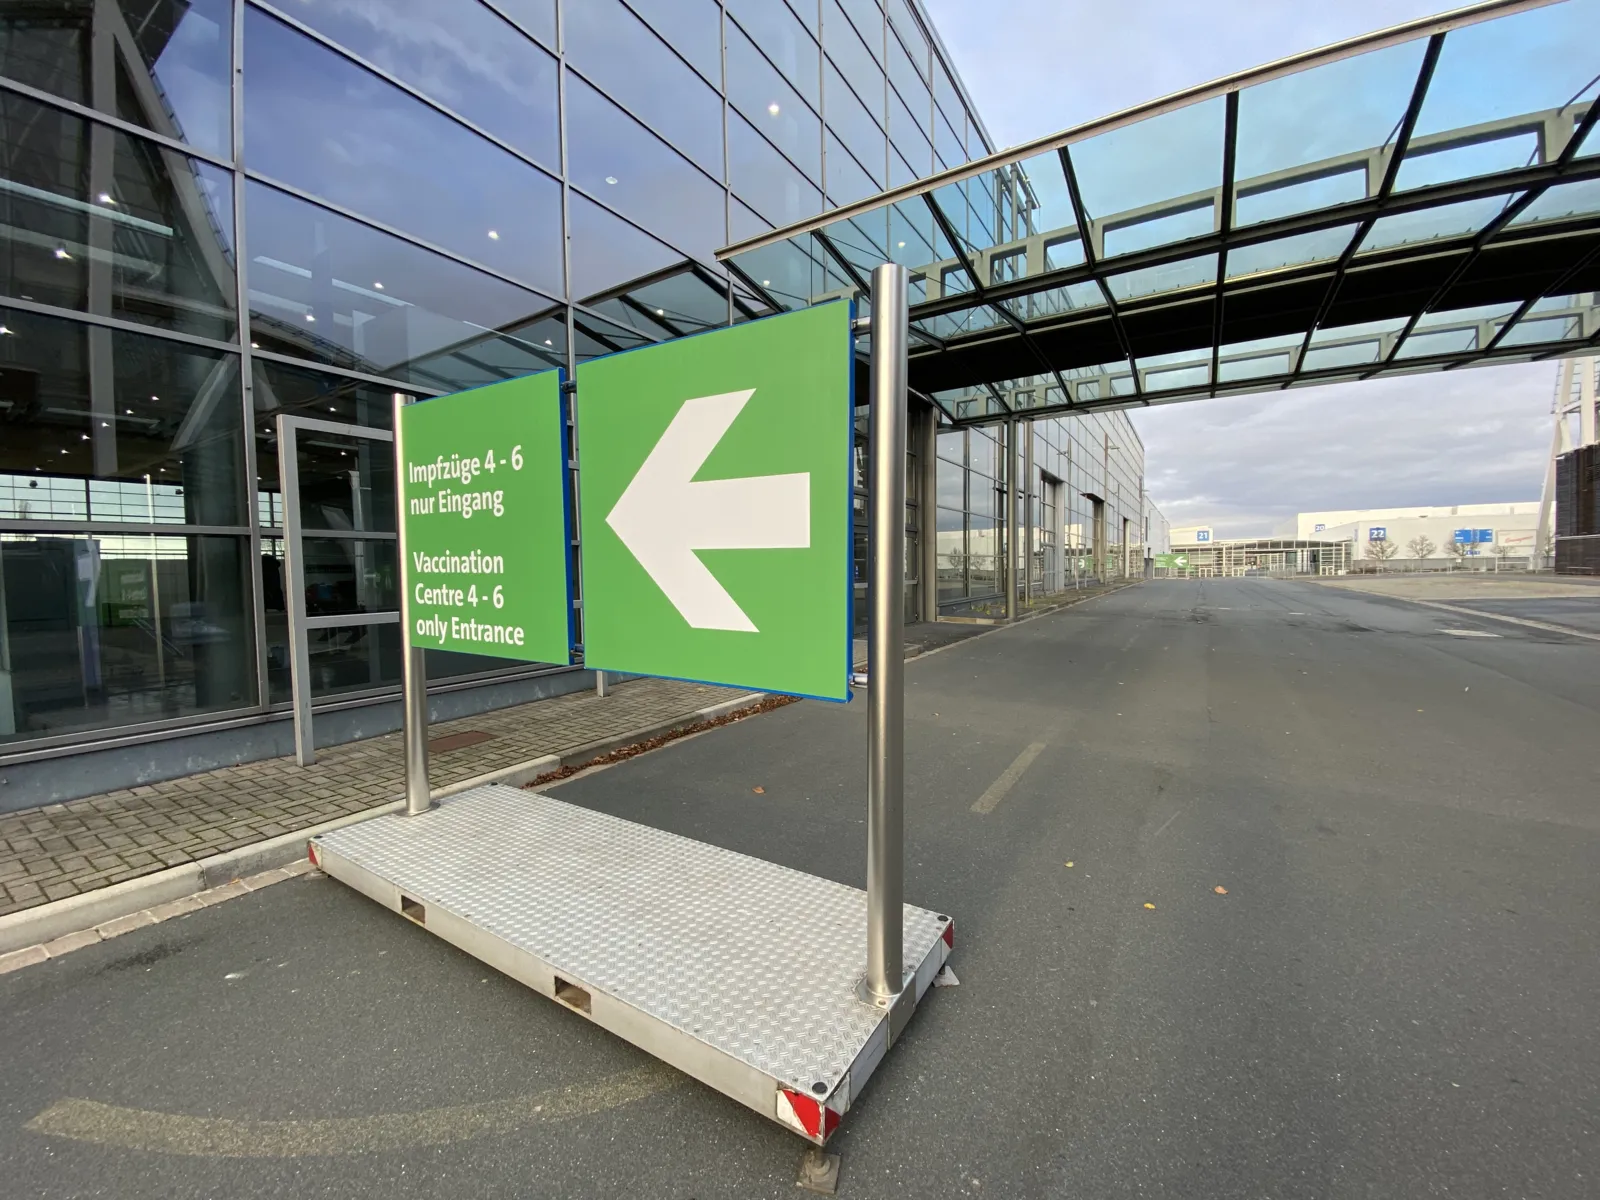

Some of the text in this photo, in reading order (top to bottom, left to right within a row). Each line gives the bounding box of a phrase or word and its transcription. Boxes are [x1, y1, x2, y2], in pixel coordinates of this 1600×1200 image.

[408, 454, 481, 489] Impfzüge
[484, 449, 496, 474] 4
[511, 444, 524, 471] 6
[410, 488, 505, 519] nur Eingang
[1370, 530, 1385, 538] 22
[413, 549, 504, 574] Vaccination
[414, 583, 464, 606] Centre
[467, 584, 479, 608] 4
[492, 584, 505, 609] 6
[416, 613, 525, 646] only Entrance
